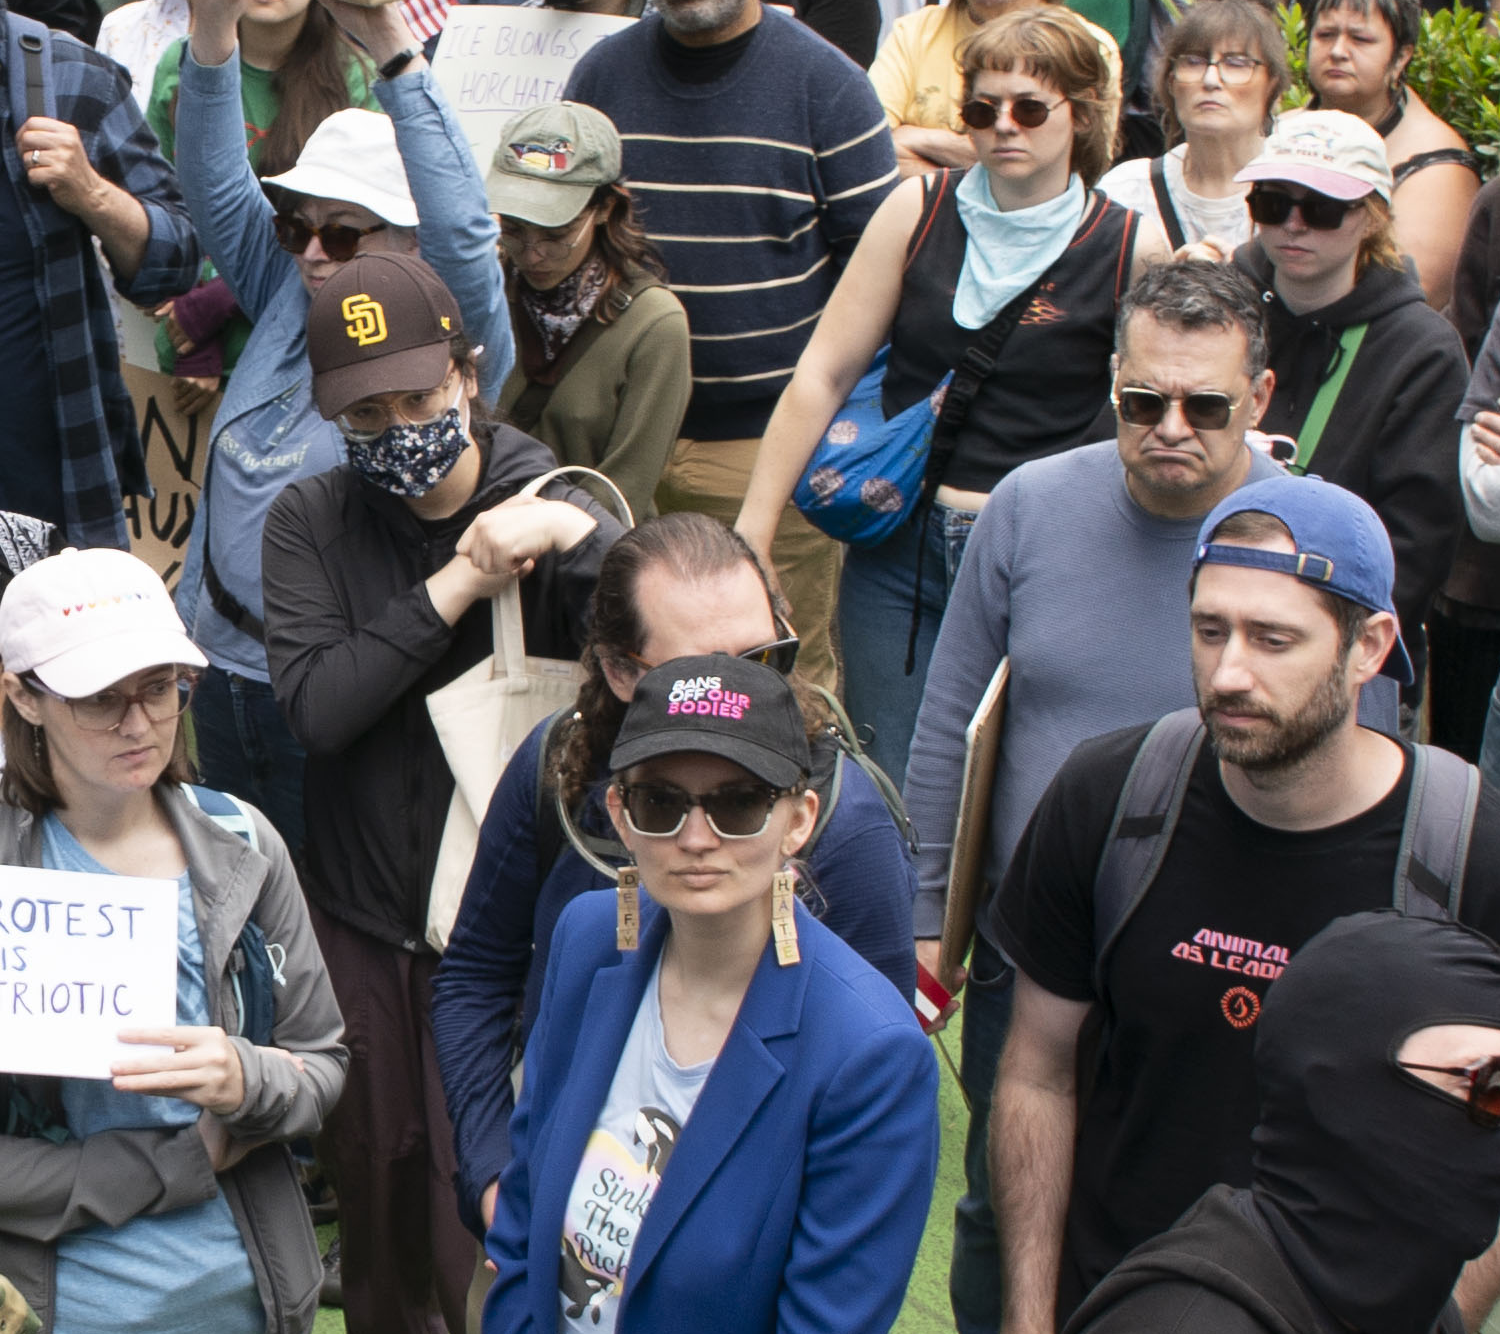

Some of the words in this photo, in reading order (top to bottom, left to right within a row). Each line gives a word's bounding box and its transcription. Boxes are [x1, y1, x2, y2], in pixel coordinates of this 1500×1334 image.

[444, 25, 486, 60] ICE
[494, 25, 581, 59] BLONGS
[672, 676, 722, 693] BANS
[668, 688, 706, 705] OFF
[706, 688, 752, 708] OUR
[667, 700, 743, 719] BODIES
[2, 946, 28, 971] IS
[1172, 943, 1203, 963] AS
[585, 1200, 630, 1250] The
